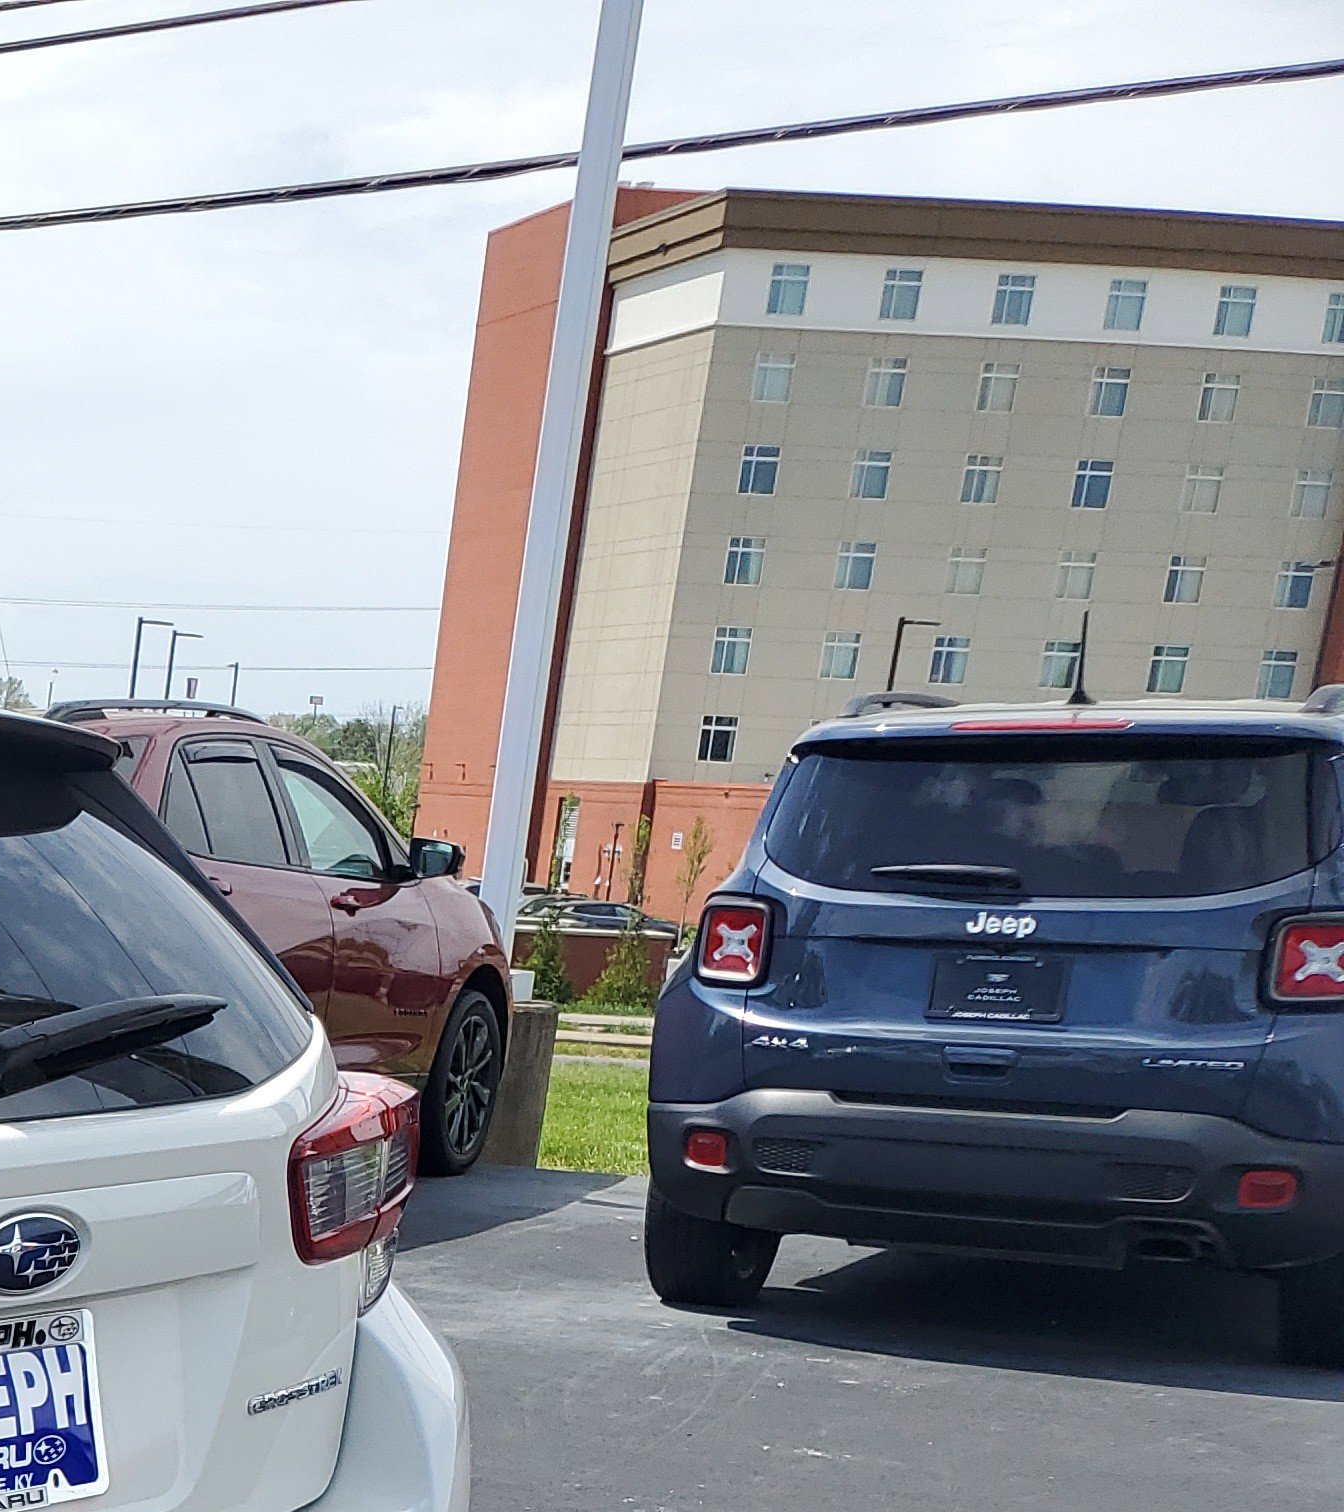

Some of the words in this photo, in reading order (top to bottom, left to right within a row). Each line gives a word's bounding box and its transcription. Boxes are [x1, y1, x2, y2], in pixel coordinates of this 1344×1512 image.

[966, 911, 1037, 939] Jeep
[967, 994, 1022, 1002] CADILLAC
[14, 1472, 34, 1491] KY
